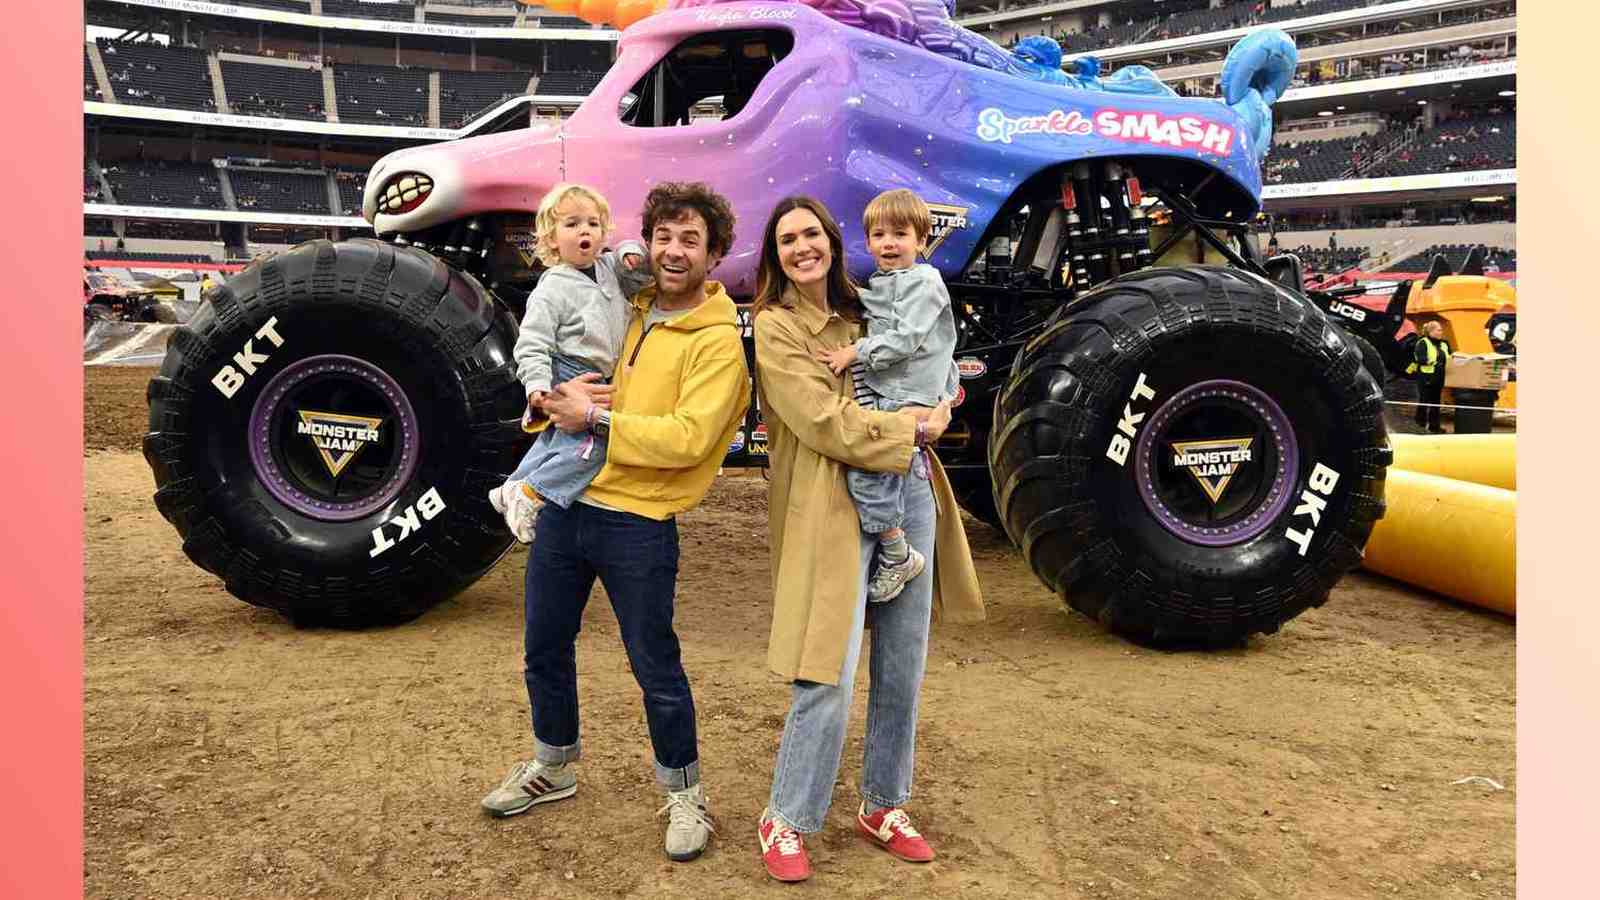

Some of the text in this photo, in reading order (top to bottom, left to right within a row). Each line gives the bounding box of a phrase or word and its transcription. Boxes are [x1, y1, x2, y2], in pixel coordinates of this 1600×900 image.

[976, 107, 1231, 153] Sparkle SMASH
[928, 214, 967, 229] STER
[1329, 302, 1366, 322] JCB
[211, 316, 285, 399] BKT
[1106, 372, 1156, 467] BKT
[298, 422, 379, 442] MONSTER
[319, 439, 356, 451] JAM
[1174, 449, 1251, 467] MONSTER
[1198, 463, 1232, 477] JAM
[1285, 462, 1340, 556] BKT
[369, 486, 447, 558] BKT
